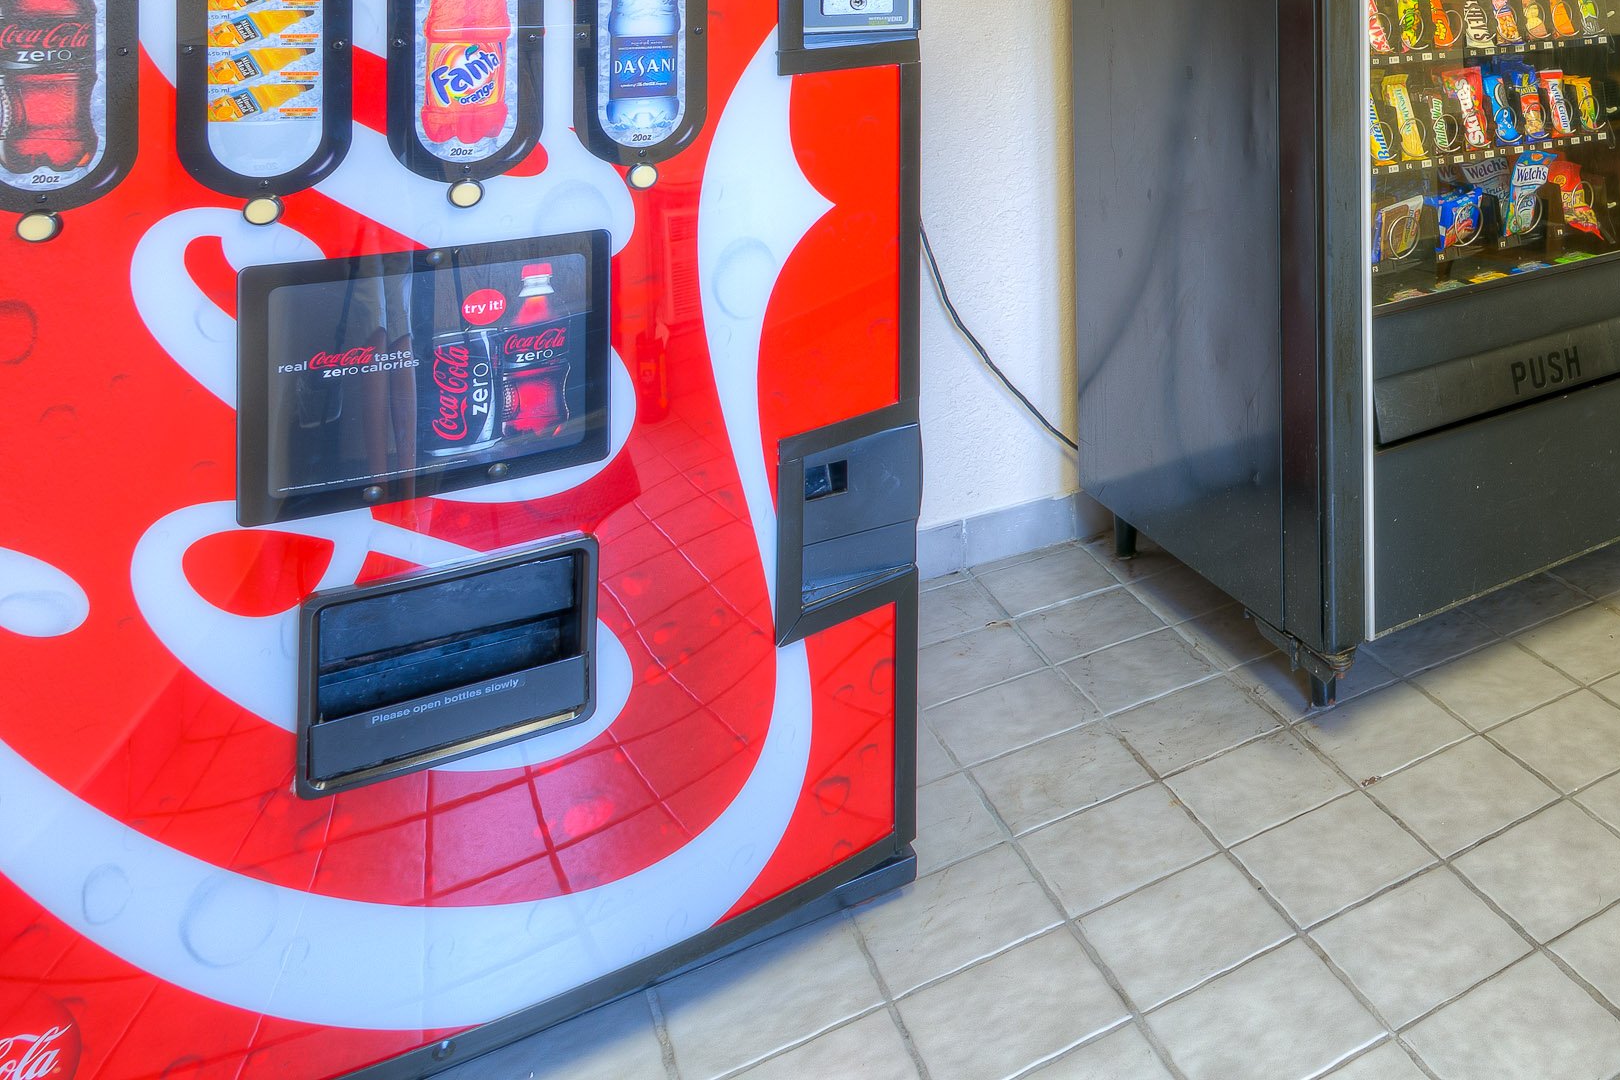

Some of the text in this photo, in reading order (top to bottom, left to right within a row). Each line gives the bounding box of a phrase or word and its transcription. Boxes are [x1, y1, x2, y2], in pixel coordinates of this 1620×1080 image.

[0, 22, 92, 50] Coca-Cola
[17, 49, 72, 62] zero
[614, 55, 675, 77] DASANI
[431, 50, 500, 105] Fanta
[459, 80, 495, 104] orange
[1432, 98, 1449, 148] Milky Way
[1455, 78, 1486, 146] SKITTLES
[632, 133, 652, 142] 20oz
[450, 147, 474, 157] 20oz
[31, 174, 61, 184] 20oz
[1466, 158, 1508, 180] Welch's
[1516, 166, 1548, 182] Welch's
[1438, 253, 1445, 261] F5
[1372, 265, 1379, 273] F3
[464, 299, 504, 316] try it!
[504, 327, 567, 353] Coca-Cola
[278, 345, 412, 374] real Coca-Cola taste
[515, 348, 554, 363] zero
[323, 357, 420, 378] zero calories
[1510, 345, 1582, 395] PUSH
[432, 344, 470, 441] Coca-Cola
[472, 362, 489, 416] zero
[371, 678, 520, 725] Please open bottles slowly
